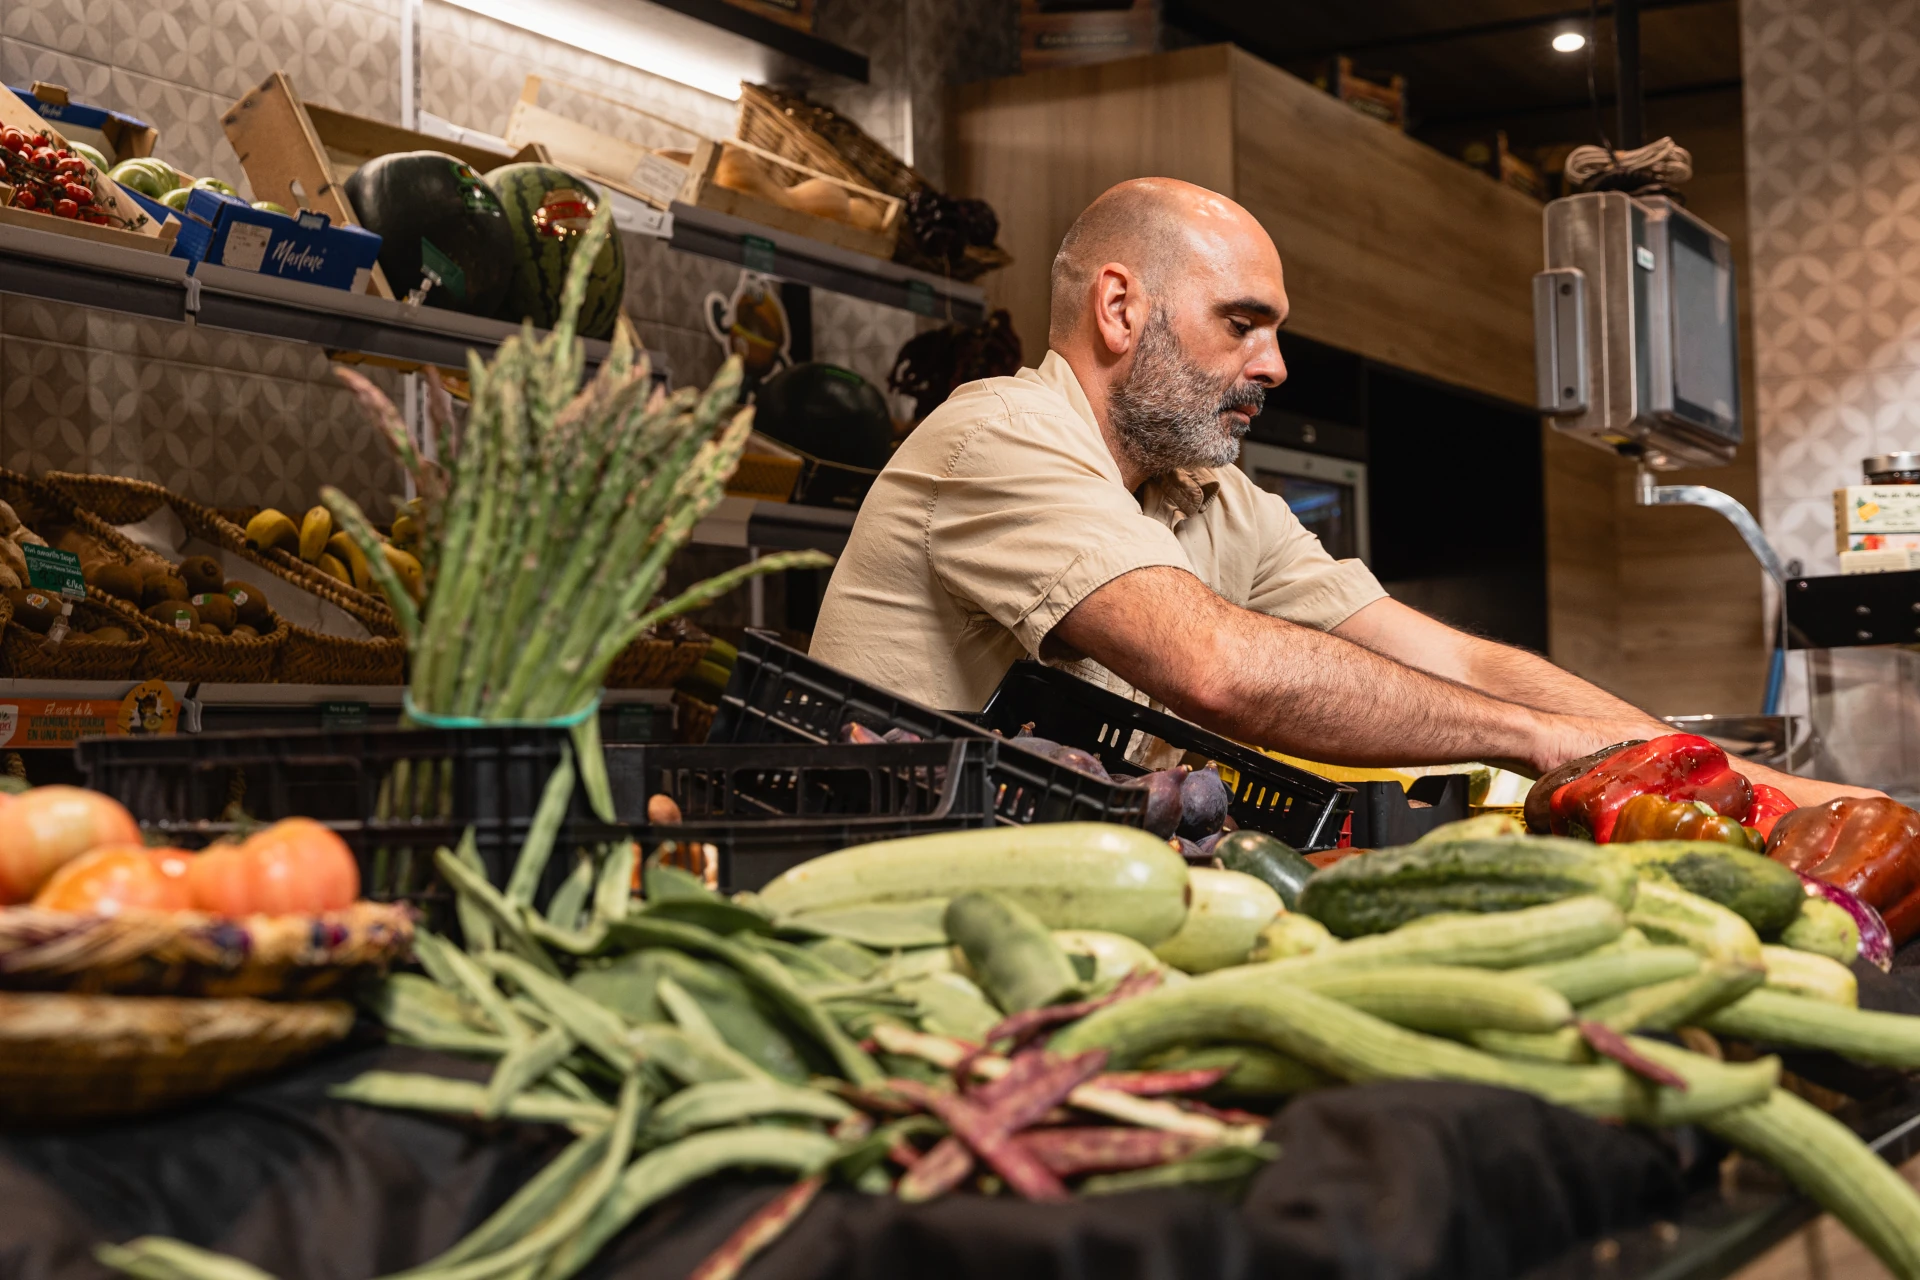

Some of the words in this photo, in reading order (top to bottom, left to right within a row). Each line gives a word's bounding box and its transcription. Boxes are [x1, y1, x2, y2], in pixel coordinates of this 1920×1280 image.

[271, 239, 325, 274] Marlene
[30, 716, 69, 727] VITAMINA
[71, 716, 78, 727] C
[79, 716, 105, 727] DIARIA
[27, 729, 38, 741] EN
[40, 729, 58, 741] UNA
[59, 729, 80, 741] SOLA
